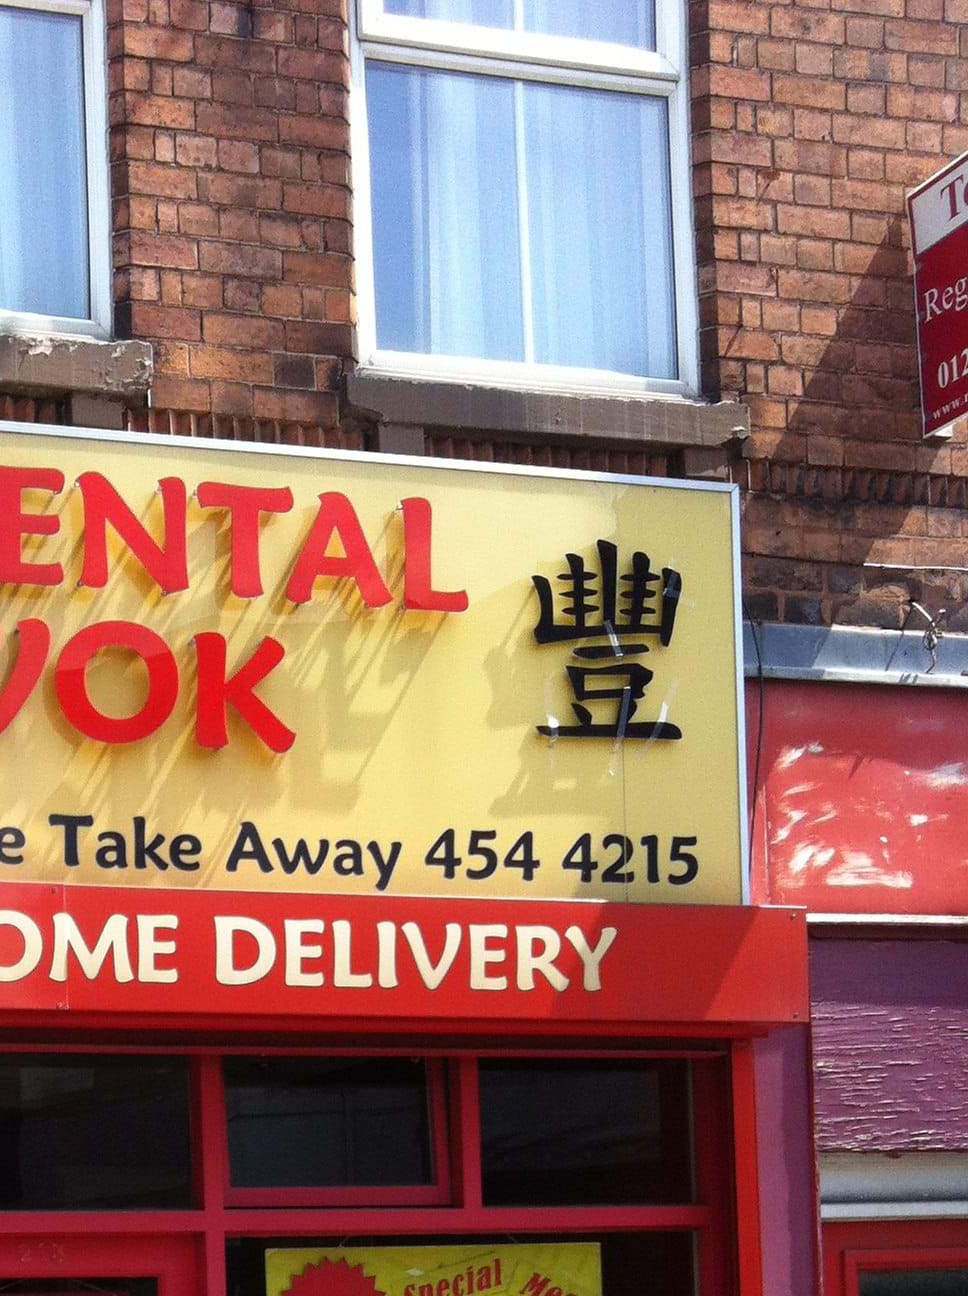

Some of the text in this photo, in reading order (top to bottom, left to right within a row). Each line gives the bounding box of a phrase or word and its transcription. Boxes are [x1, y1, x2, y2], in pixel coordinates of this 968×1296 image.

[48, 813, 203, 872] Take
[225, 821, 402, 891] Away
[423, 828, 540, 884] 454
[561, 833, 700, 887] 4215
[213, 914, 618, 995] DELIVERY
